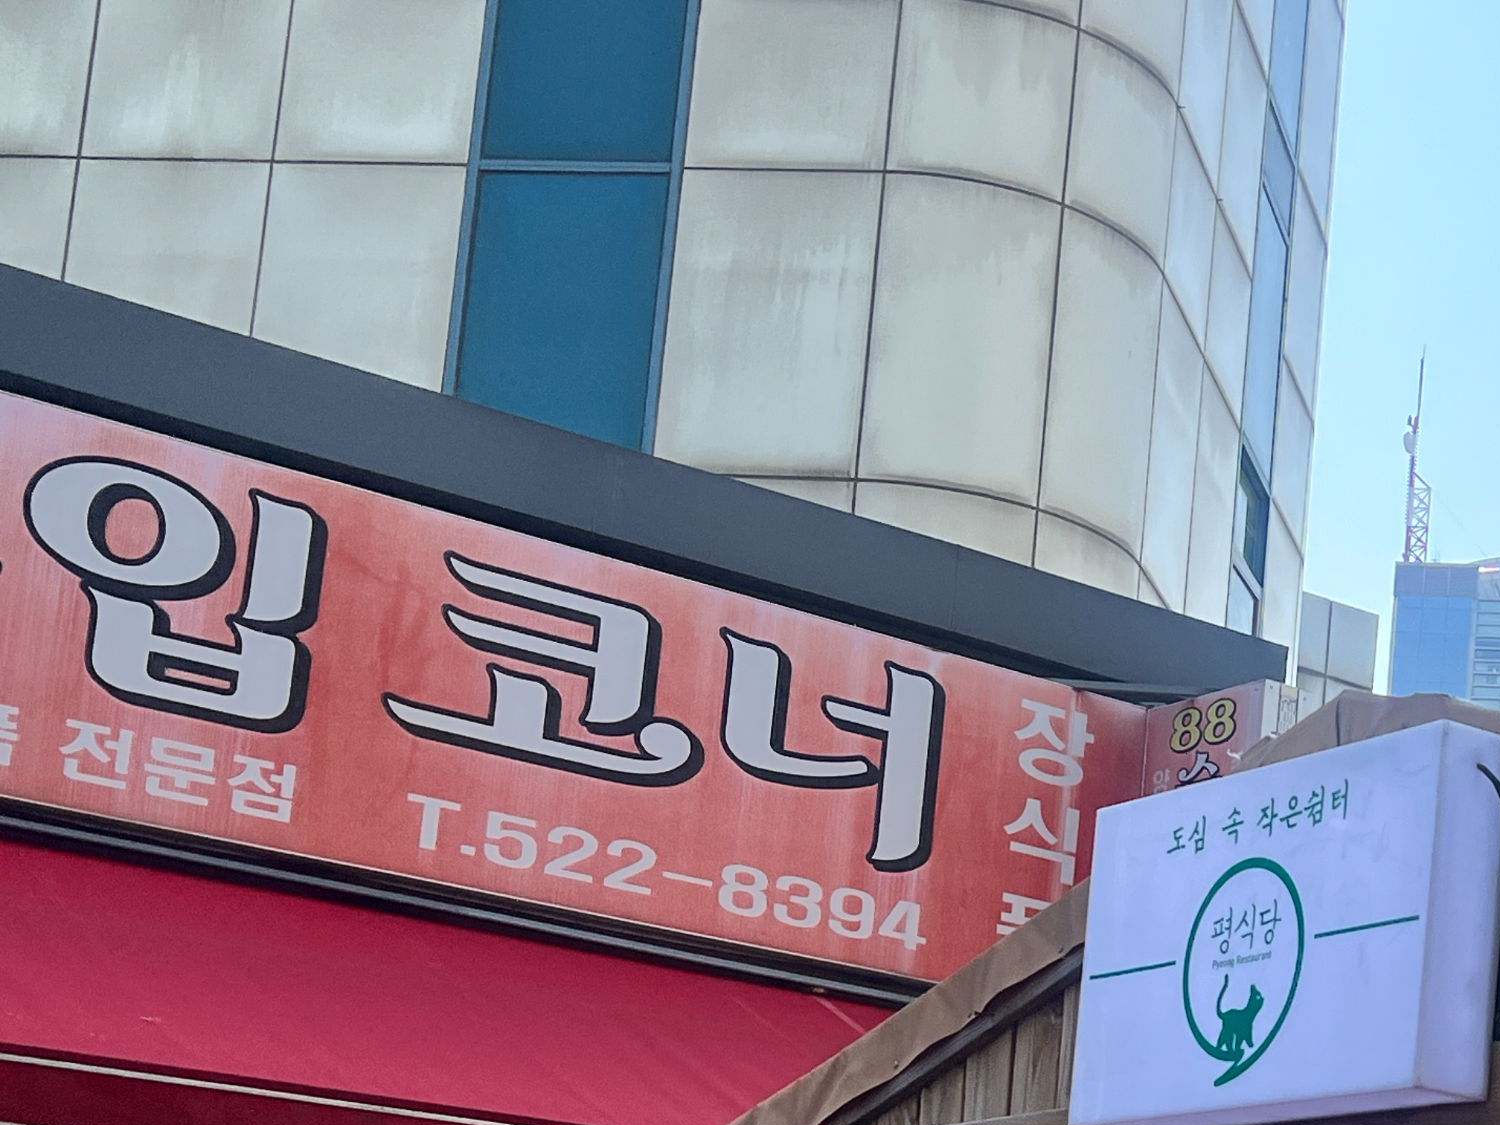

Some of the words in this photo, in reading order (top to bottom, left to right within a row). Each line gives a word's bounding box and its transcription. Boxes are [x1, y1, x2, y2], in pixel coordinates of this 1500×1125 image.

[23, 455, 328, 733] 입
[1170, 698, 1237, 753] 88
[59, 718, 297, 823] 전문점
[1166, 815, 1207, 855] 도심
[1222, 806, 1244, 845] 속
[407, 793, 927, 951] T.522-8394
[1211, 899, 1282, 954] 평식당
[1236, 950, 1272, 965] Restaurant
